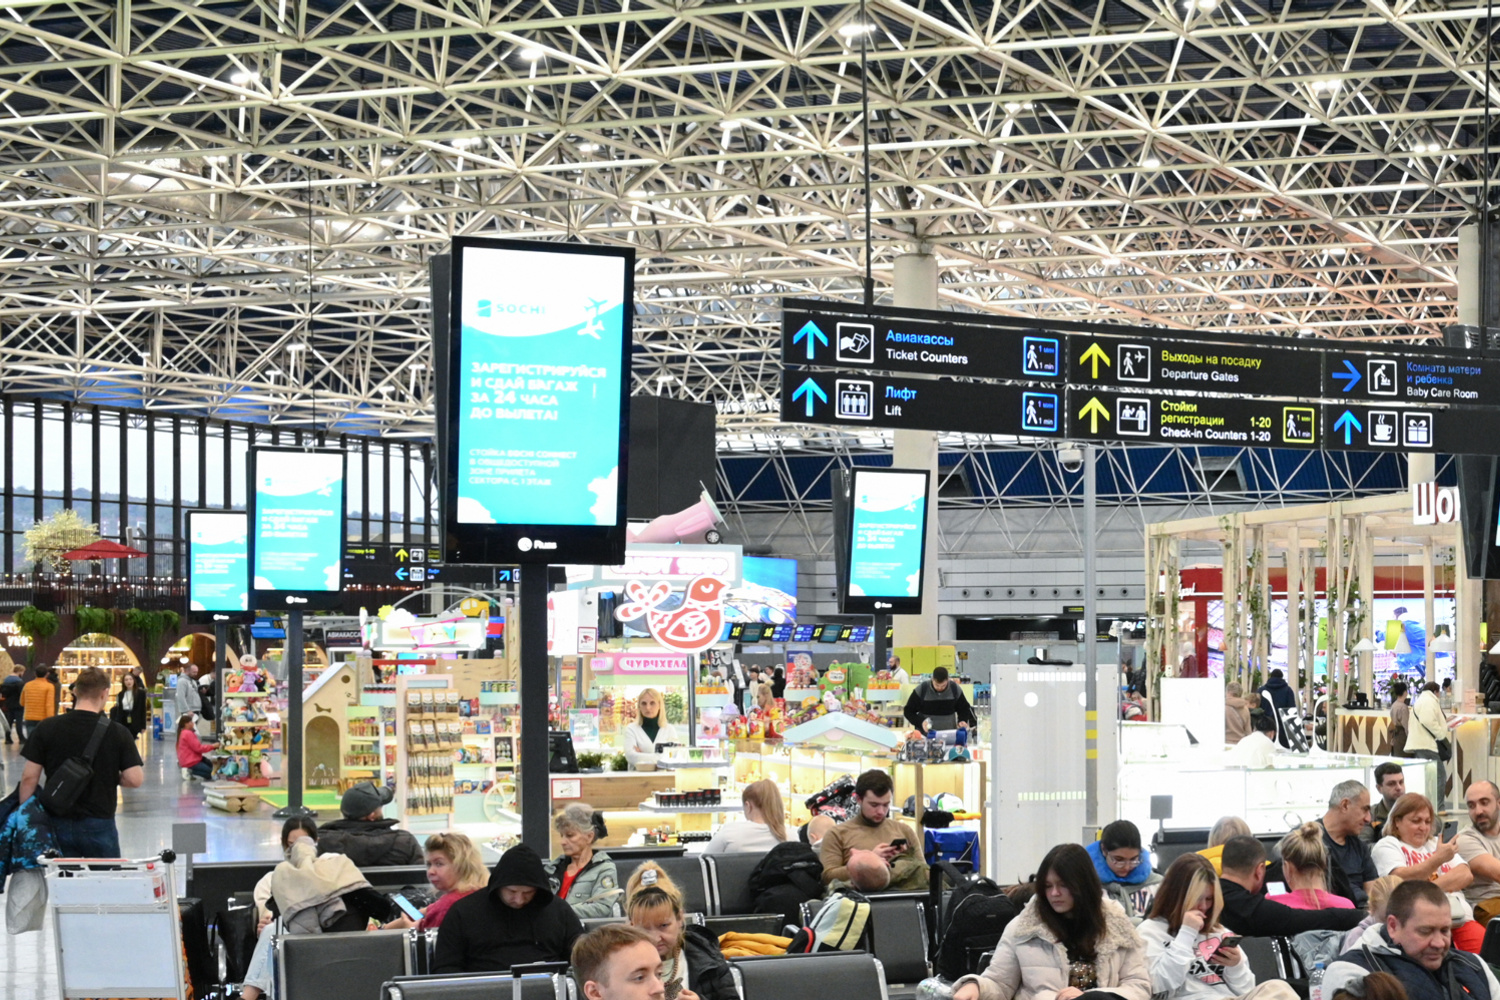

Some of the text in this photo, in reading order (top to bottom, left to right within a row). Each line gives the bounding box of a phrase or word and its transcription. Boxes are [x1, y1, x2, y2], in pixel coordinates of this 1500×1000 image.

[496, 304, 545, 314] SOCHI
[886, 330, 954, 346] Авиакассы
[886, 348, 968, 364] Ticket Counters
[1162, 350, 1262, 370] Выходы на посадку
[471, 362, 606, 378] ЗАРЕГИСТРИРУЙСЯ
[1161, 368, 1239, 382] Departure Gates
[1406, 362, 1481, 377] Комната матери
[1415, 374, 1453, 385] ребенка
[494, 391, 516, 404] 24
[885, 386, 917, 401] Лифт
[1406, 386, 1478, 399] Baby Care Room
[885, 404, 902, 416] Lift
[1161, 400, 1197, 412] Стойки
[1161, 414, 1271, 428] регистрации 1-20
[1161, 426, 1271, 442] Check-in Counters 1-20
